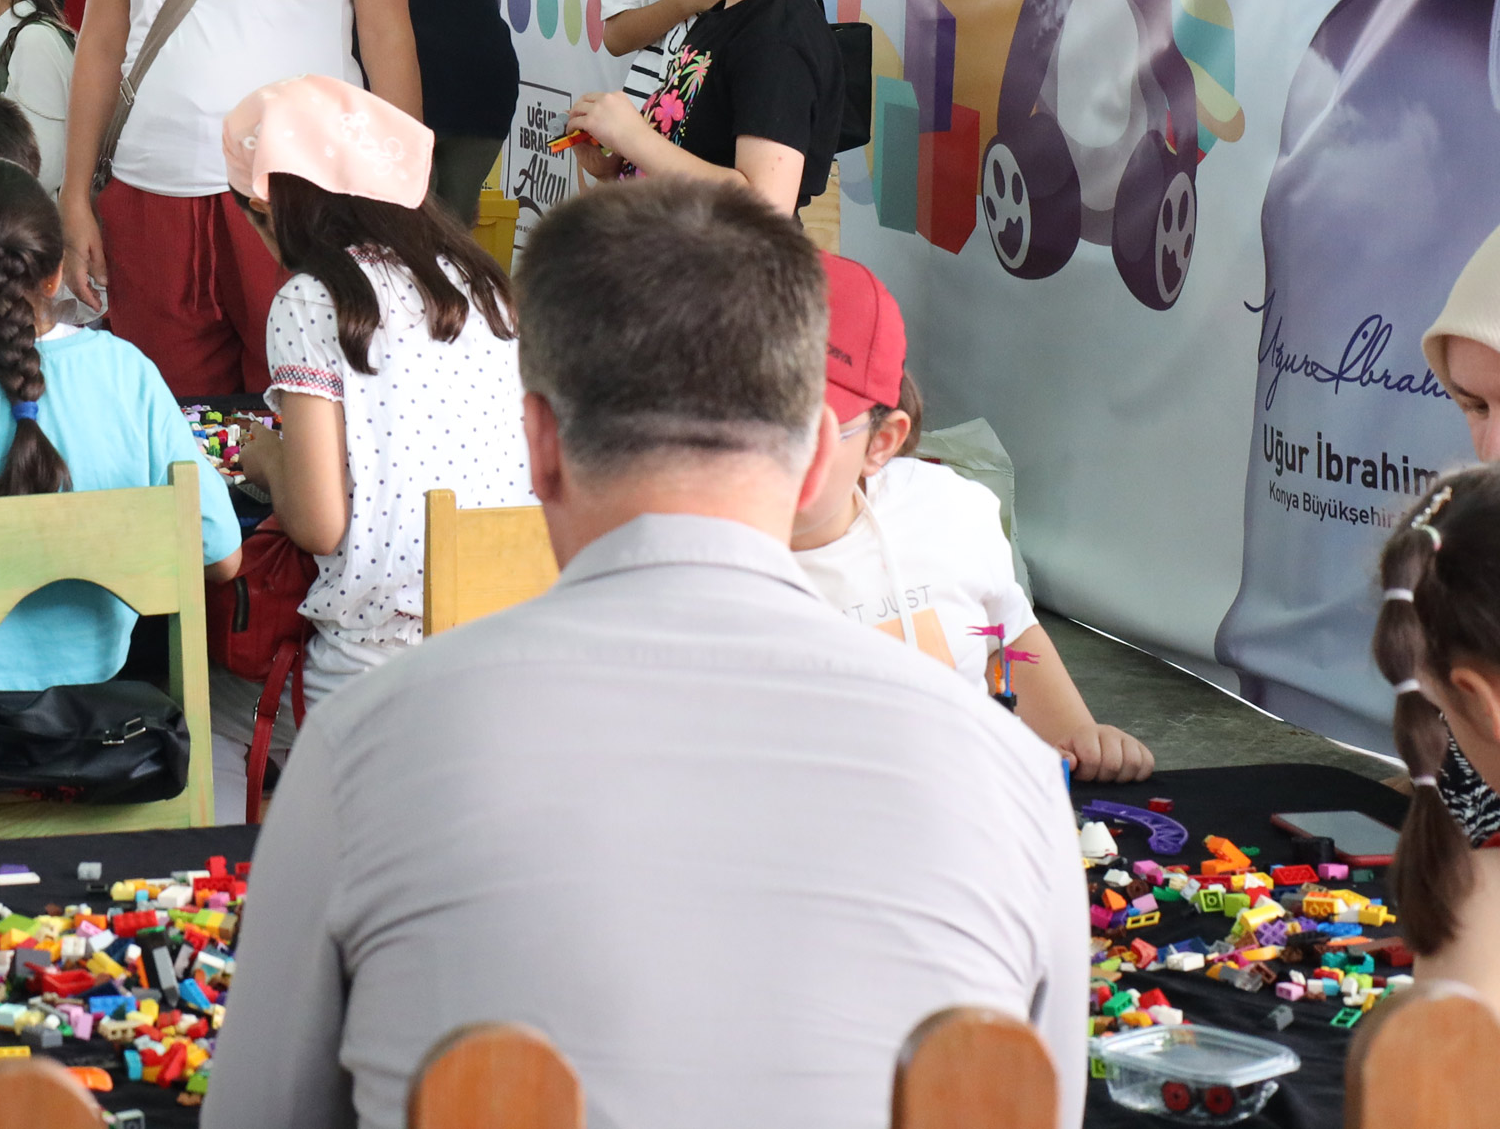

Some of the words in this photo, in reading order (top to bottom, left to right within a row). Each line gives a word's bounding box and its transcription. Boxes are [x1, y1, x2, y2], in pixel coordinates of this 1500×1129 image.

[1263, 423, 1310, 478] Uğur
[1269, 479, 1300, 513] Konya
[876, 584, 931, 618] JUST
